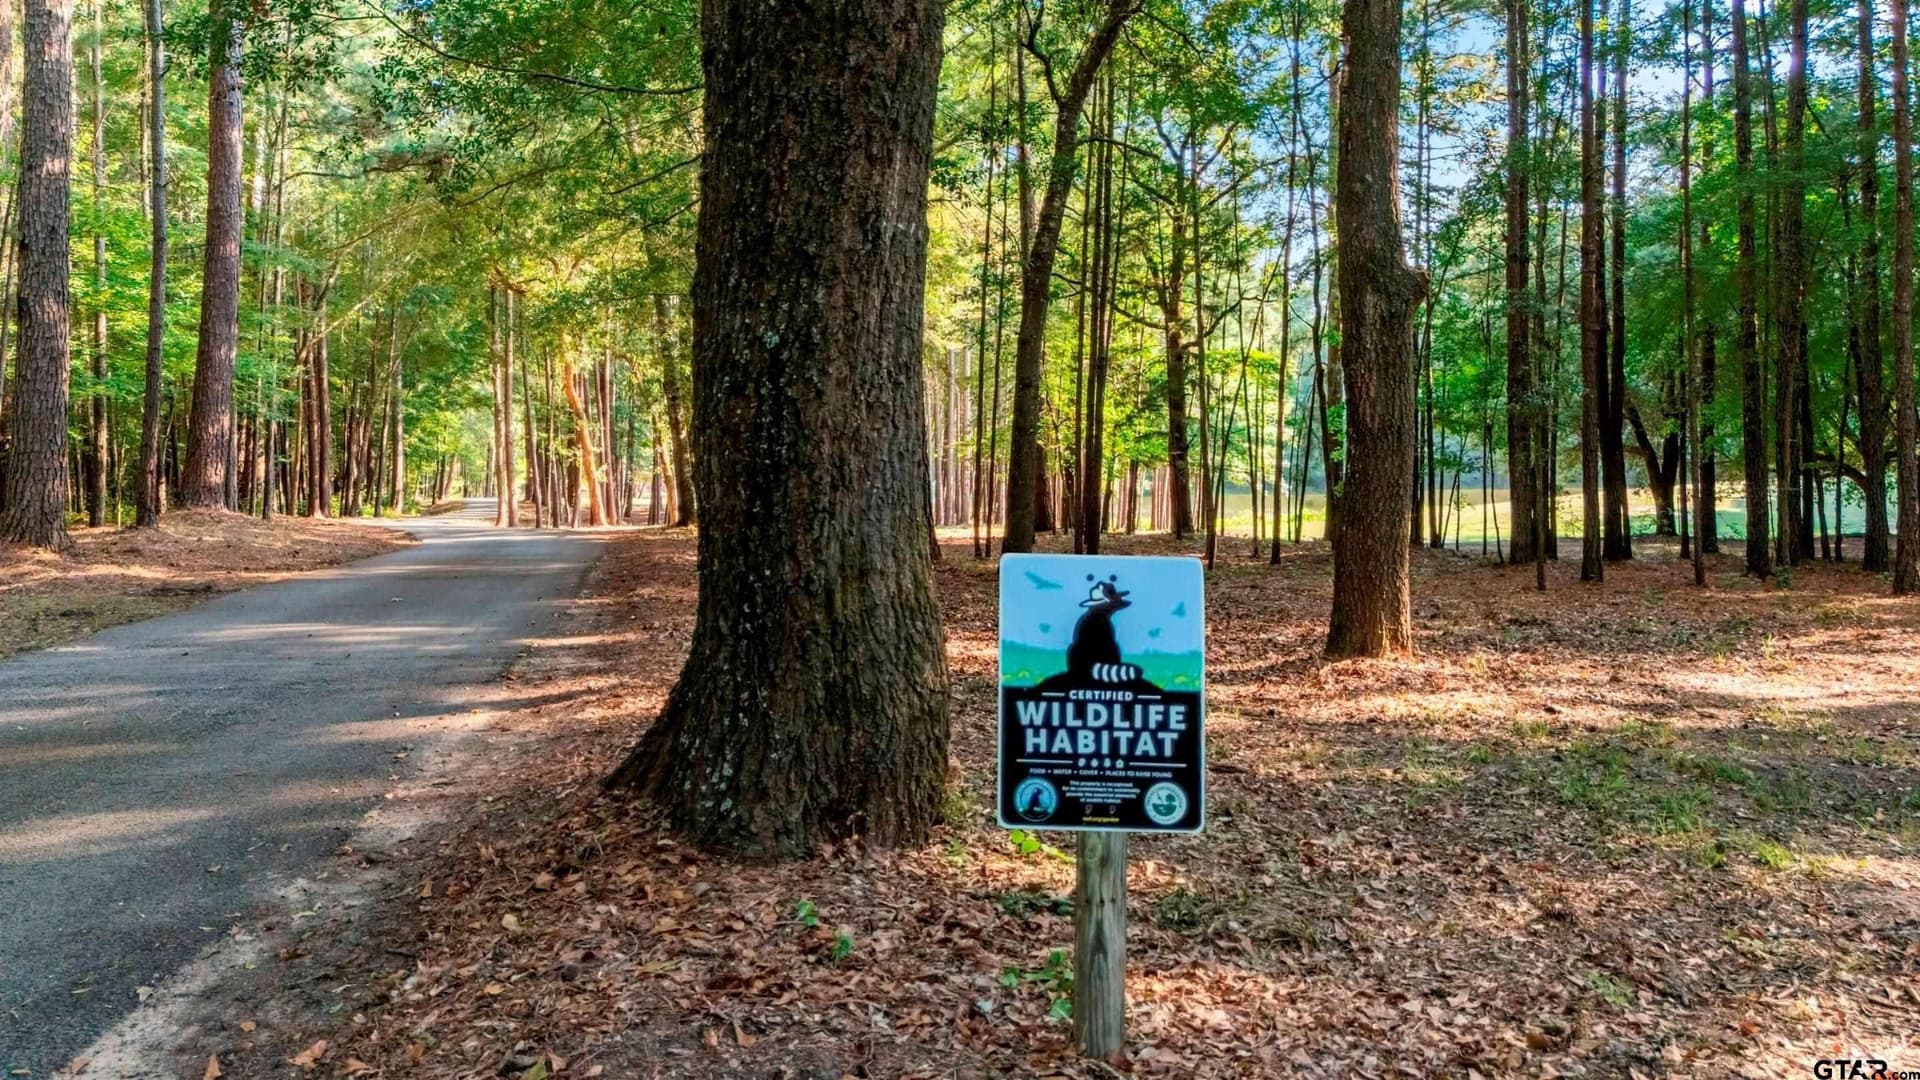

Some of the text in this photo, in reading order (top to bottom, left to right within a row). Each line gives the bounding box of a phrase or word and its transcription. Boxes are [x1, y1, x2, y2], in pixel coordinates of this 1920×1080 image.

[1069, 690, 1133, 701] CERTIFIED
[1016, 701, 1186, 730] WILDLIFE
[1025, 728, 1178, 757] HABITAT
